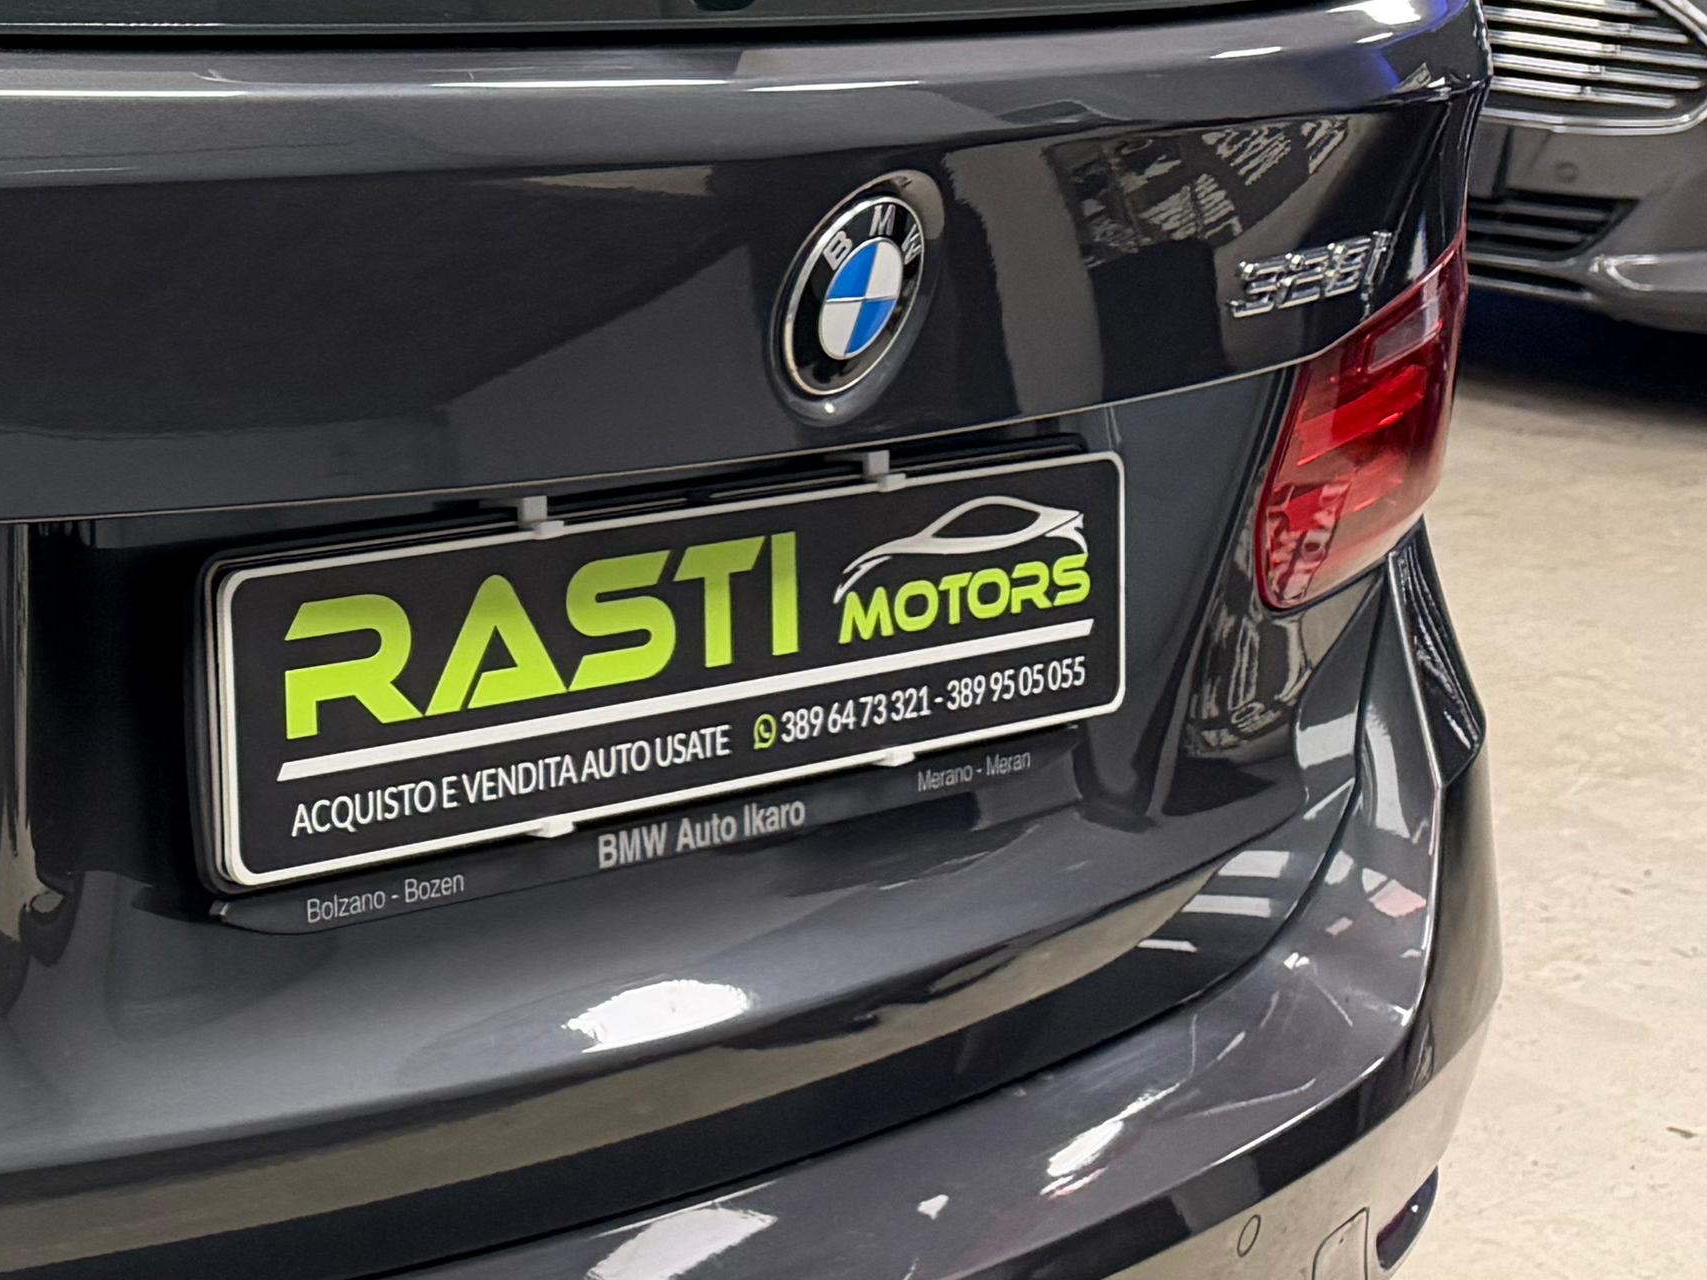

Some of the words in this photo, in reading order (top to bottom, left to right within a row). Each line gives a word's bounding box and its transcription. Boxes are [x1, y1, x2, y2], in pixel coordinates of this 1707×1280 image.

[823, 204, 922, 271] BMW
[839, 554, 1090, 645] MOTORS
[285, 531, 799, 740] RASTI
[291, 780, 437, 837] ACQUISTO
[442, 774, 459, 809] E
[462, 753, 578, 803] VENDITA
[581, 741, 651, 780] AUTO
[654, 724, 732, 768] USATE
[780, 706, 823, 744] 389
[827, 699, 856, 734] 64
[858, 694, 888, 728] 73
[890, 686, 932, 722] 321
[946, 674, 985, 711] 389
[989, 669, 1015, 702] 95
[1018, 663, 1044, 697] 05
[1047, 656, 1087, 690] 055
[917, 763, 974, 792] Merano
[985, 750, 1032, 777] Meran
[597, 823, 668, 869] BMW
[675, 814, 736, 852] Auto
[743, 798, 806, 838] Ikaro
[307, 888, 386, 924] Bolzano
[404, 872, 465, 903] Bozen
